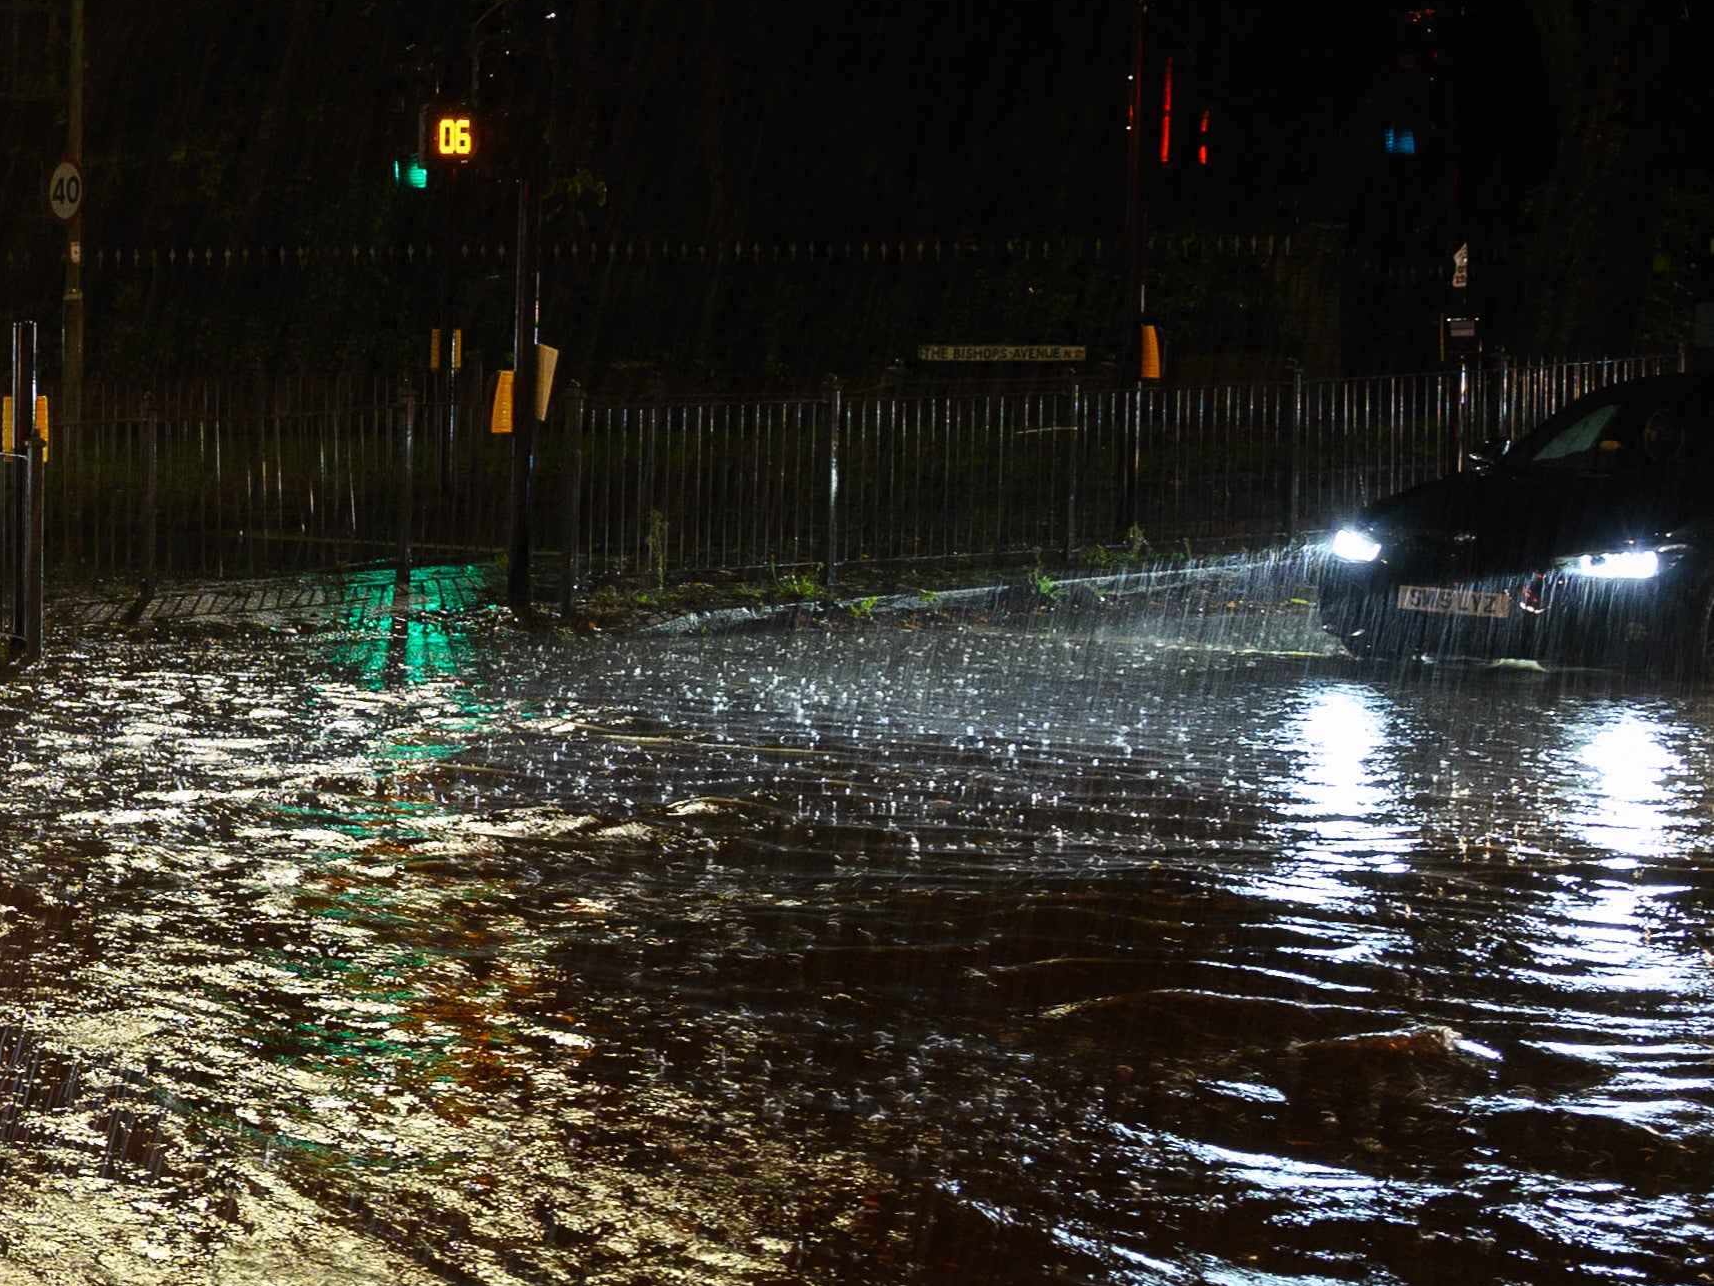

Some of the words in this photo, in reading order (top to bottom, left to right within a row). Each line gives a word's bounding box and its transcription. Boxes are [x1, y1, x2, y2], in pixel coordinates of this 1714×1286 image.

[439, 119, 471, 154] 06
[53, 177, 80, 204] 40
[923, 347, 948, 359] THE
[954, 347, 1007, 360] BISHOPS
[1014, 347, 1061, 360] AVENUE
